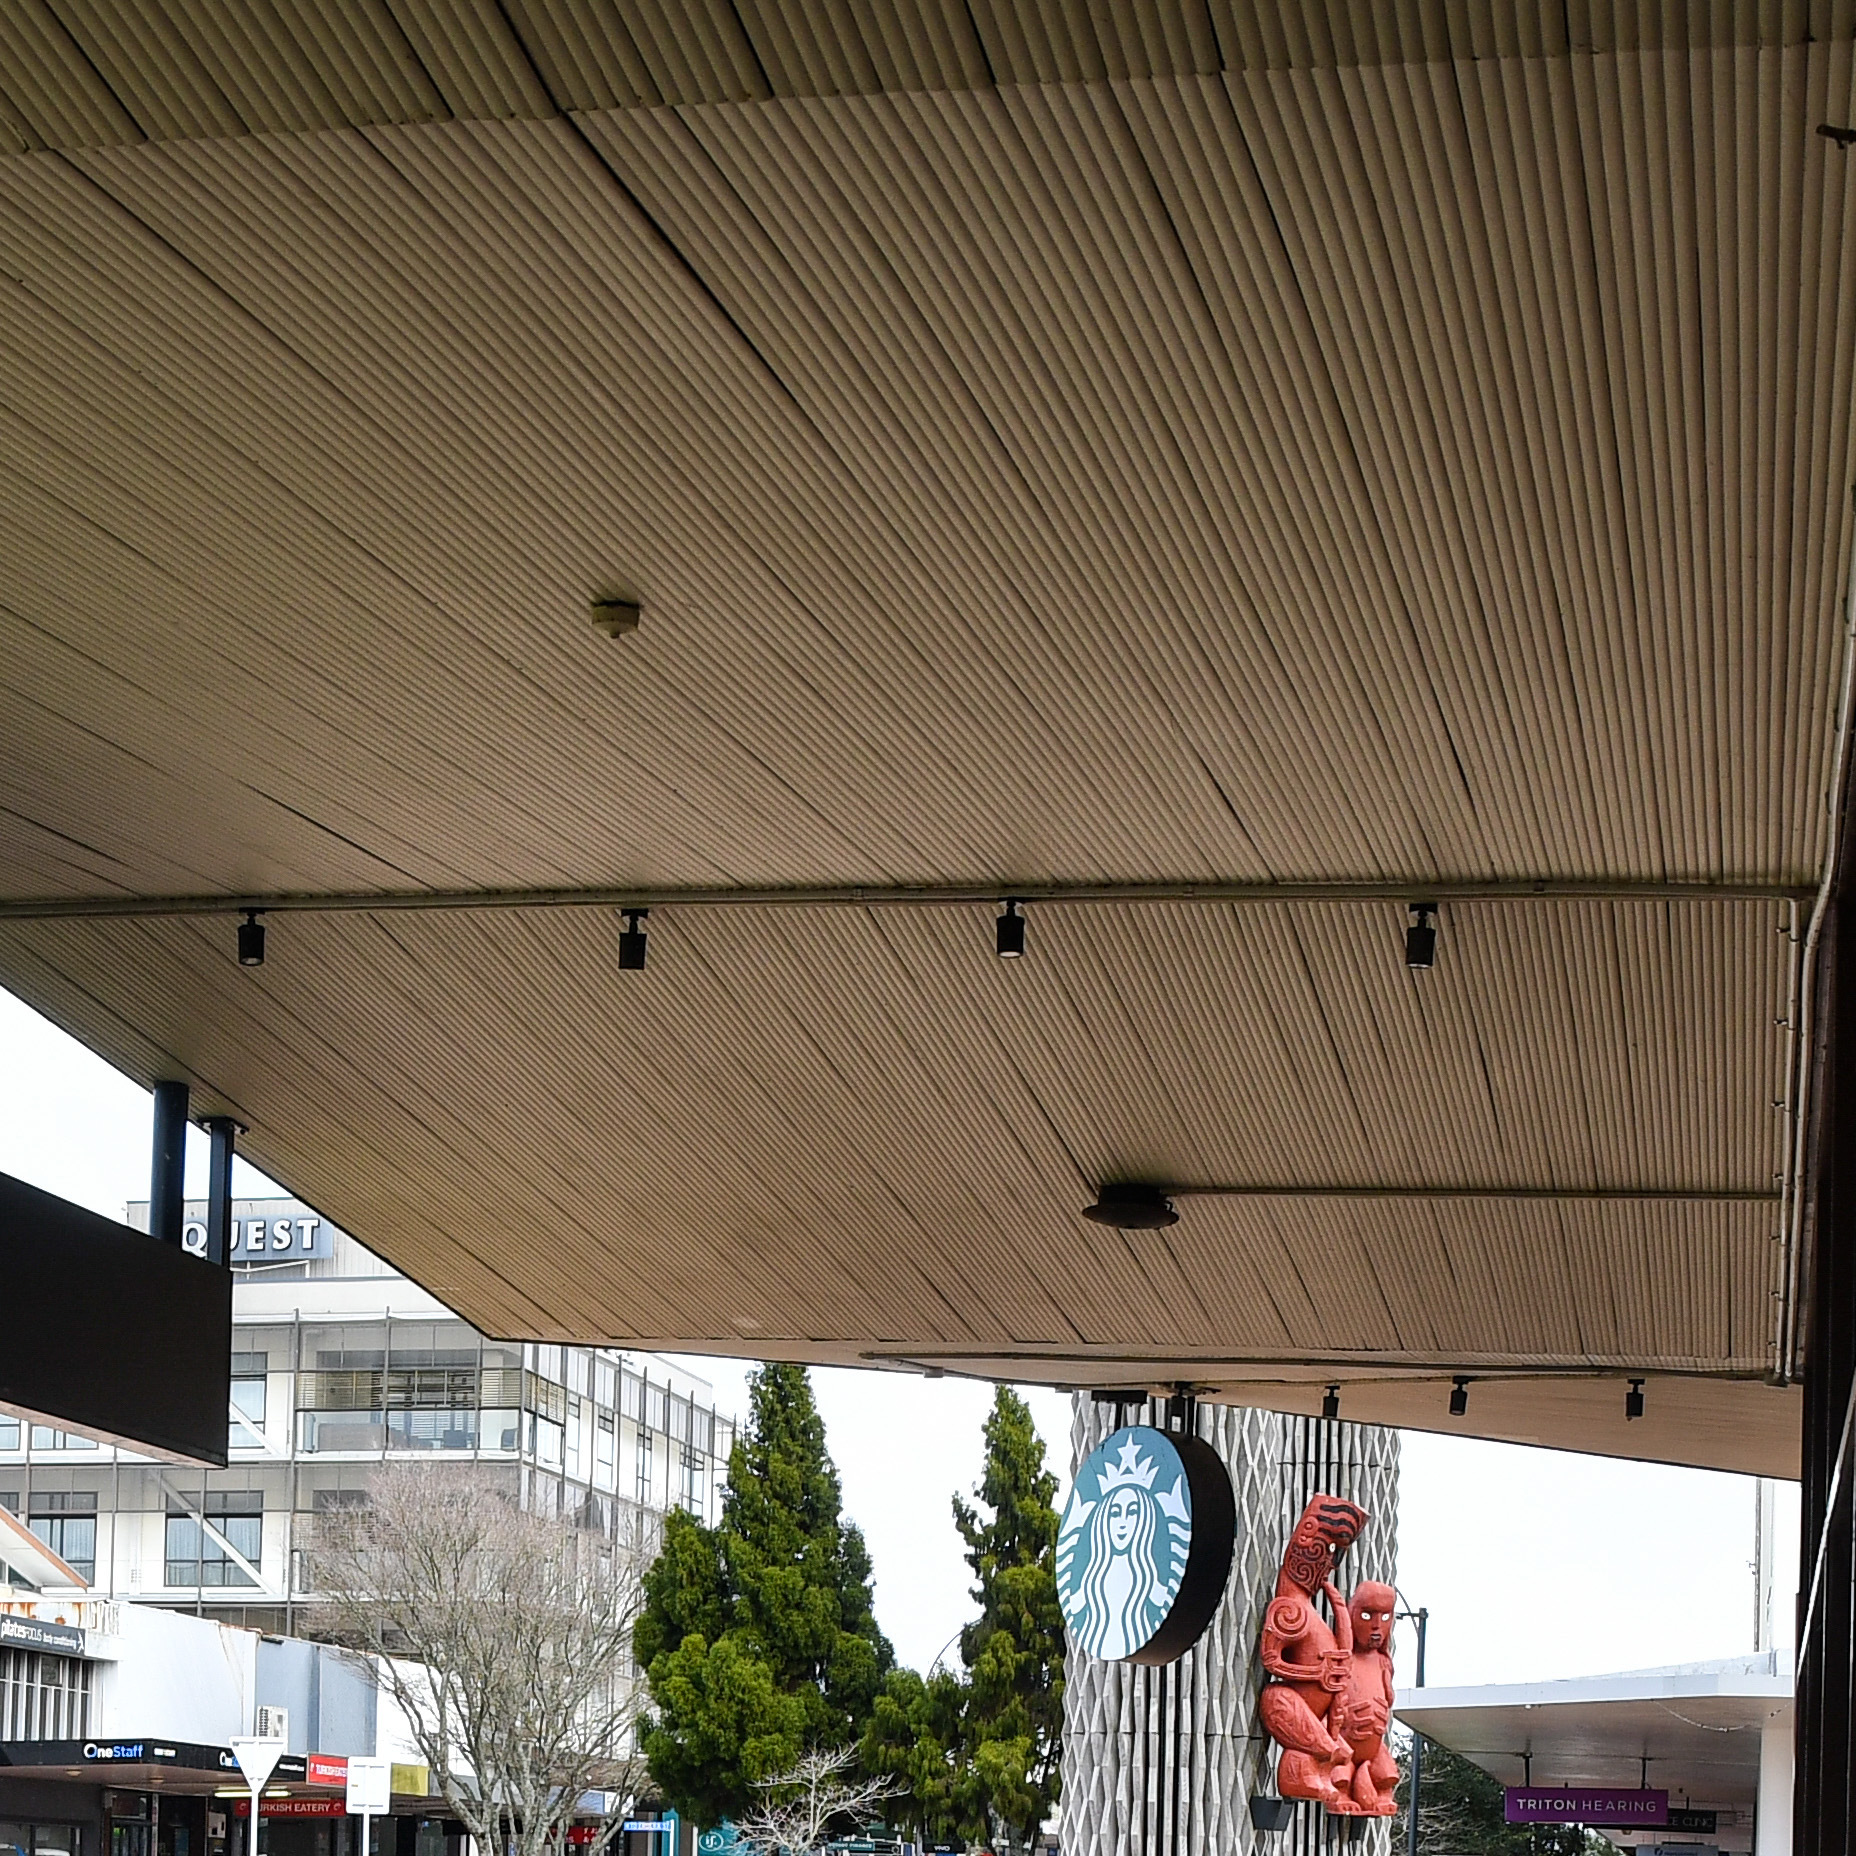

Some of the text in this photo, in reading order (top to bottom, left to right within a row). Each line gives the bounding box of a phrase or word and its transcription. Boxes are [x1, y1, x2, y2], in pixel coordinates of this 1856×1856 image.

[83, 1743, 144, 1758] OneStaff
[259, 1803, 331, 1813] URKISH EATERY
[1516, 1798, 1657, 1813] TRITON HEARING
